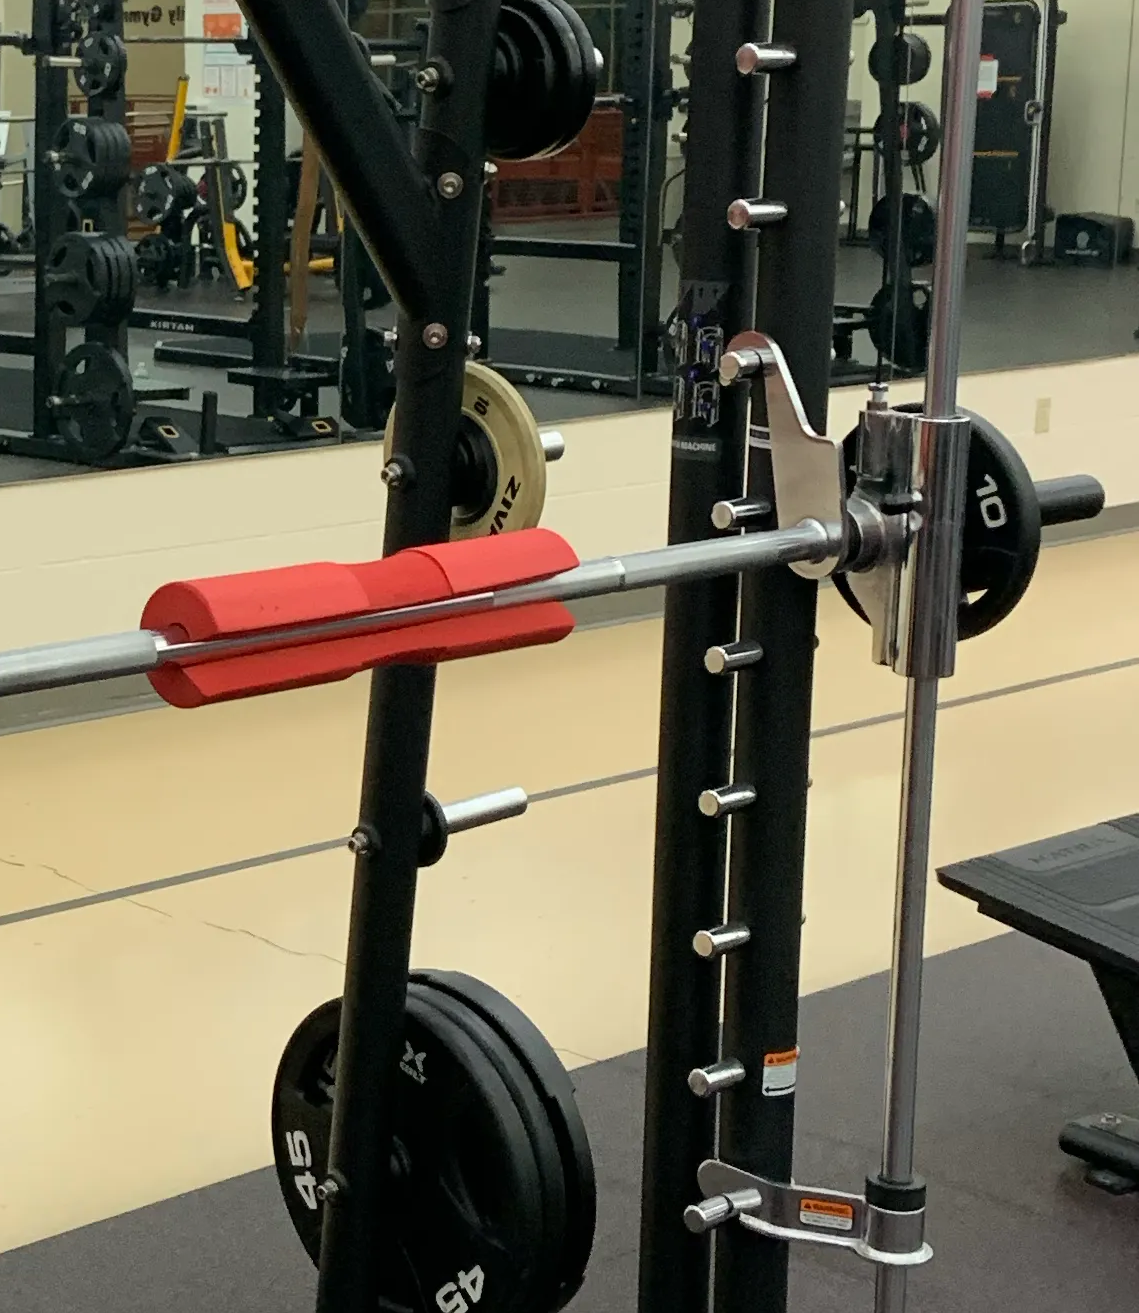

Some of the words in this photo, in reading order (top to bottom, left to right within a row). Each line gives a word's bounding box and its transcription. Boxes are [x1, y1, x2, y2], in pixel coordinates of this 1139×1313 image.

[473, 395, 490, 417] 10
[975, 473, 1008, 529] 10
[285, 1129, 319, 1210] 45
